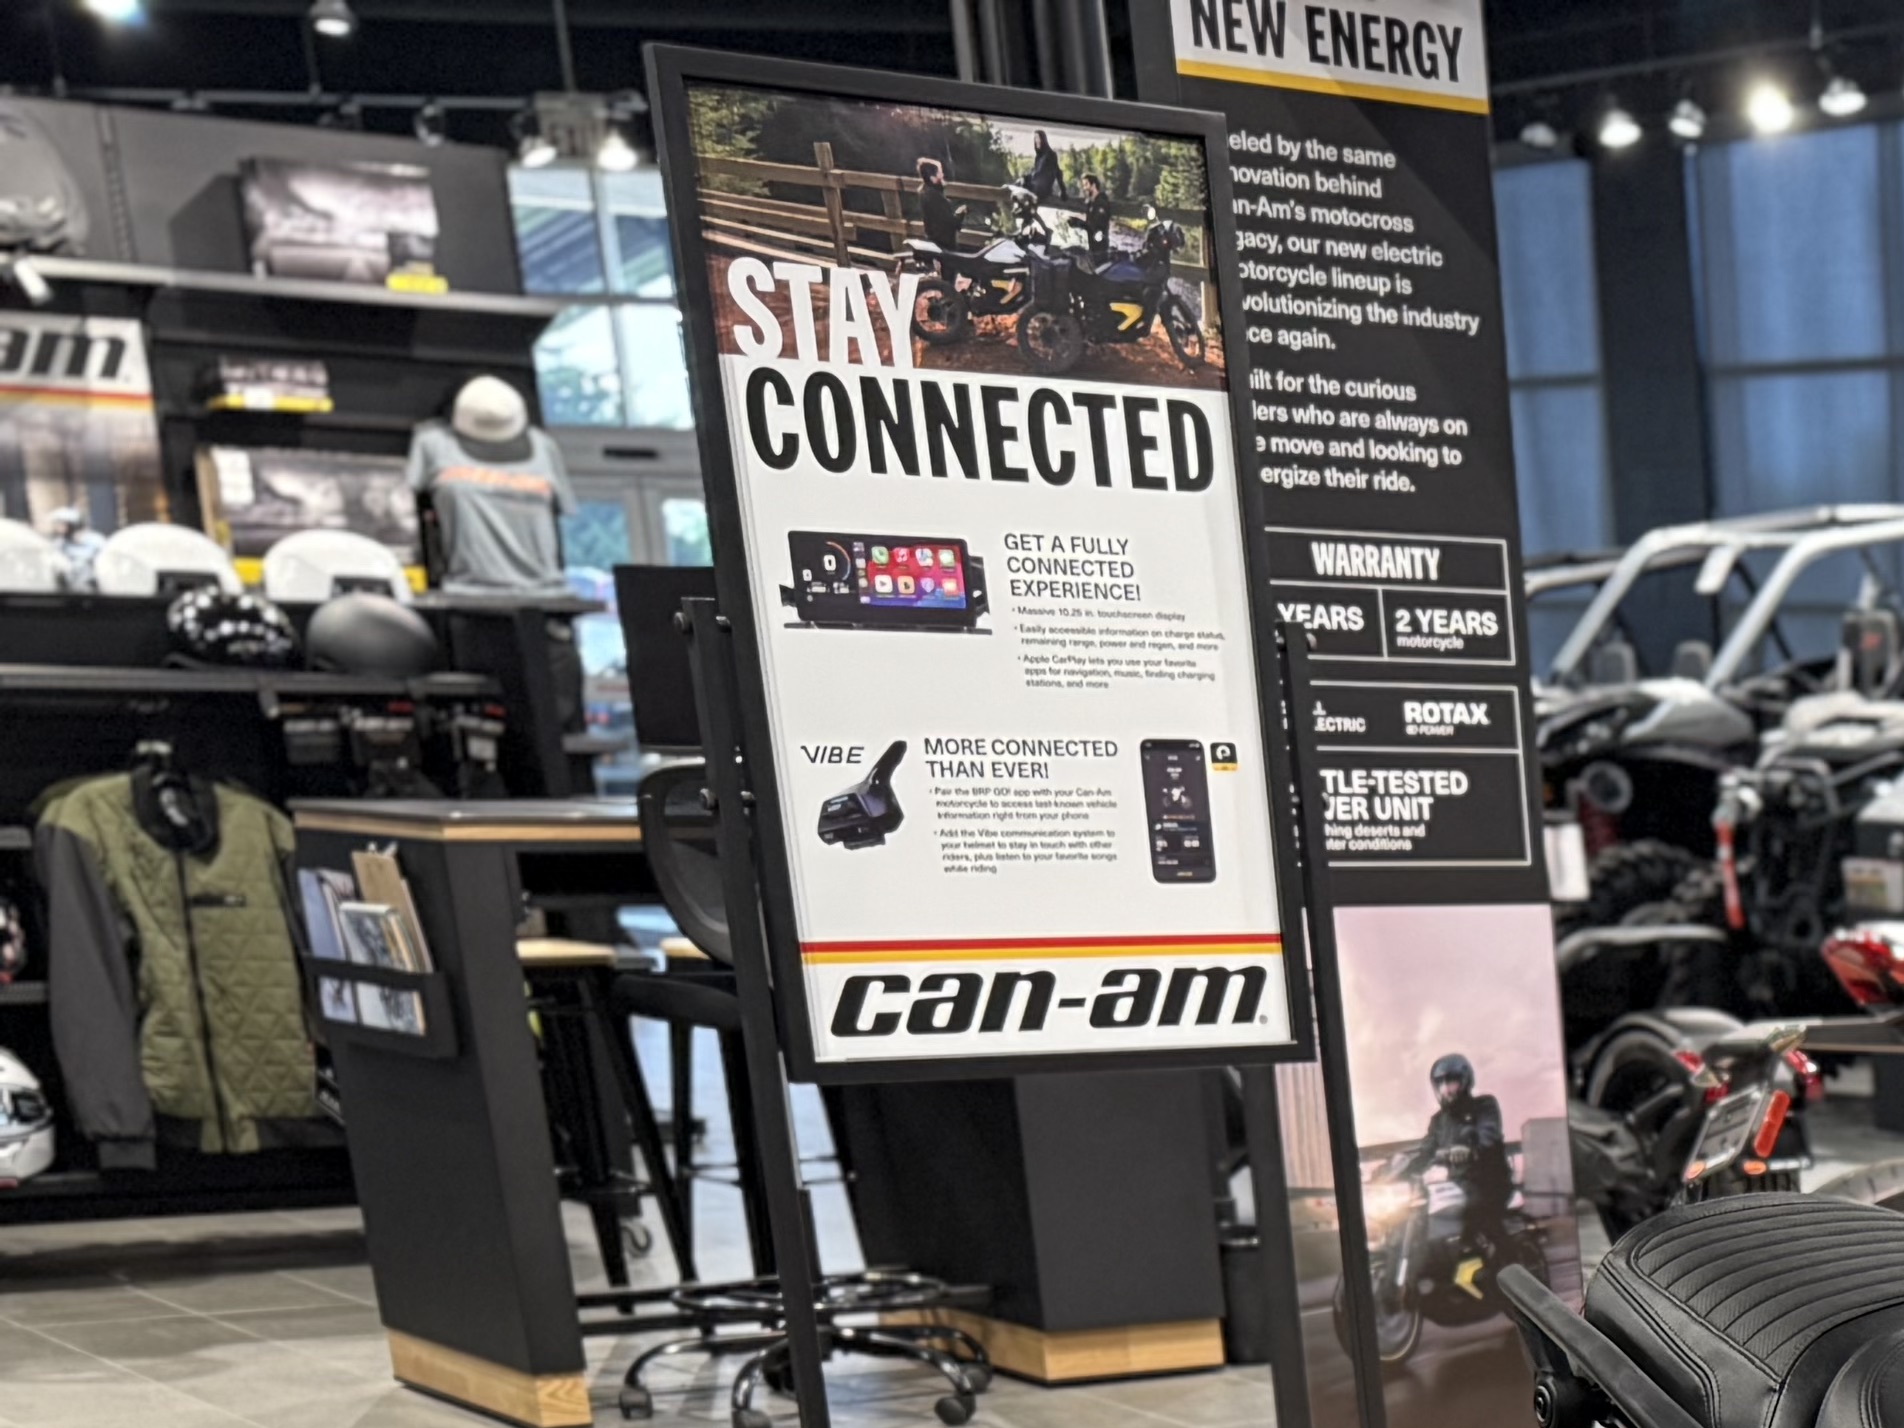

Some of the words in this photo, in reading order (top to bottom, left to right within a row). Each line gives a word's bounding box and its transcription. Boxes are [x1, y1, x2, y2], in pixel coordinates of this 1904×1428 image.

[1191, 0, 1287, 59] NEW
[1305, 5, 1463, 83] ENERGY
[1229, 133, 1272, 154] eled
[1277, 135, 1301, 160] by
[1305, 139, 1338, 162] the
[1343, 145, 1396, 169] same
[1315, 172, 1382, 198] behind
[1311, 206, 1414, 233] motocross
[1236, 230, 1283, 254] gacy,
[1288, 236, 1319, 254] our
[1325, 239, 1367, 260] new
[1371, 241, 1443, 268] electric
[1239, 262, 1327, 289] otorcycle
[1332, 269, 1391, 295] lineup
[1395, 274, 1412, 295] is
[726, 256, 923, 369] STAY
[1242, 292, 1362, 325] volutionizing
[1367, 303, 1399, 323] the
[1403, 305, 1480, 336] industry
[1278, 327, 1336, 351] again.
[1277, 371, 1304, 393] for
[1308, 373, 1340, 396] the
[1345, 377, 1416, 402] curious
[746, 366, 1215, 494] CONNECTED
[1292, 404, 1335, 427] who
[1339, 409, 1370, 429] are
[1375, 410, 1439, 437] always
[1443, 416, 1468, 436] on
[1271, 434, 1324, 456] move
[1329, 436, 1364, 458] and
[1369, 438, 1438, 466] looking
[1443, 444, 1462, 465] to
[1260, 466, 1320, 487] ergize
[1325, 466, 1368, 489] their
[1373, 470, 1415, 492] ride.
[1004, 533, 1044, 552] GET
[1051, 535, 1065, 553] A
[1071, 536, 1128, 555] FULLY
[1007, 556, 1134, 578] CONNECTED
[1311, 541, 1441, 581] WARRANTY
[1010, 579, 1141, 601] EXPERIENCE!
[1020, 624, 1046, 635] Easily
[1395, 609, 1414, 634] 2
[1415, 609, 1499, 637] YEARS
[1396, 634, 1464, 652] motorcycle
[1317, 716, 1367, 733] ECTRIC
[1404, 701, 1491, 726] ROTAX
[801, 745, 864, 764] VIBE
[924, 738, 987, 756] MORE
[991, 739, 1119, 757] CONNECTED
[926, 760, 985, 779] THAN
[992, 761, 1050, 779] EVER!
[1320, 769, 1468, 796] TLE-TESTED
[1374, 796, 1434, 821] UNIT
[830, 965, 1269, 1039] can-am
